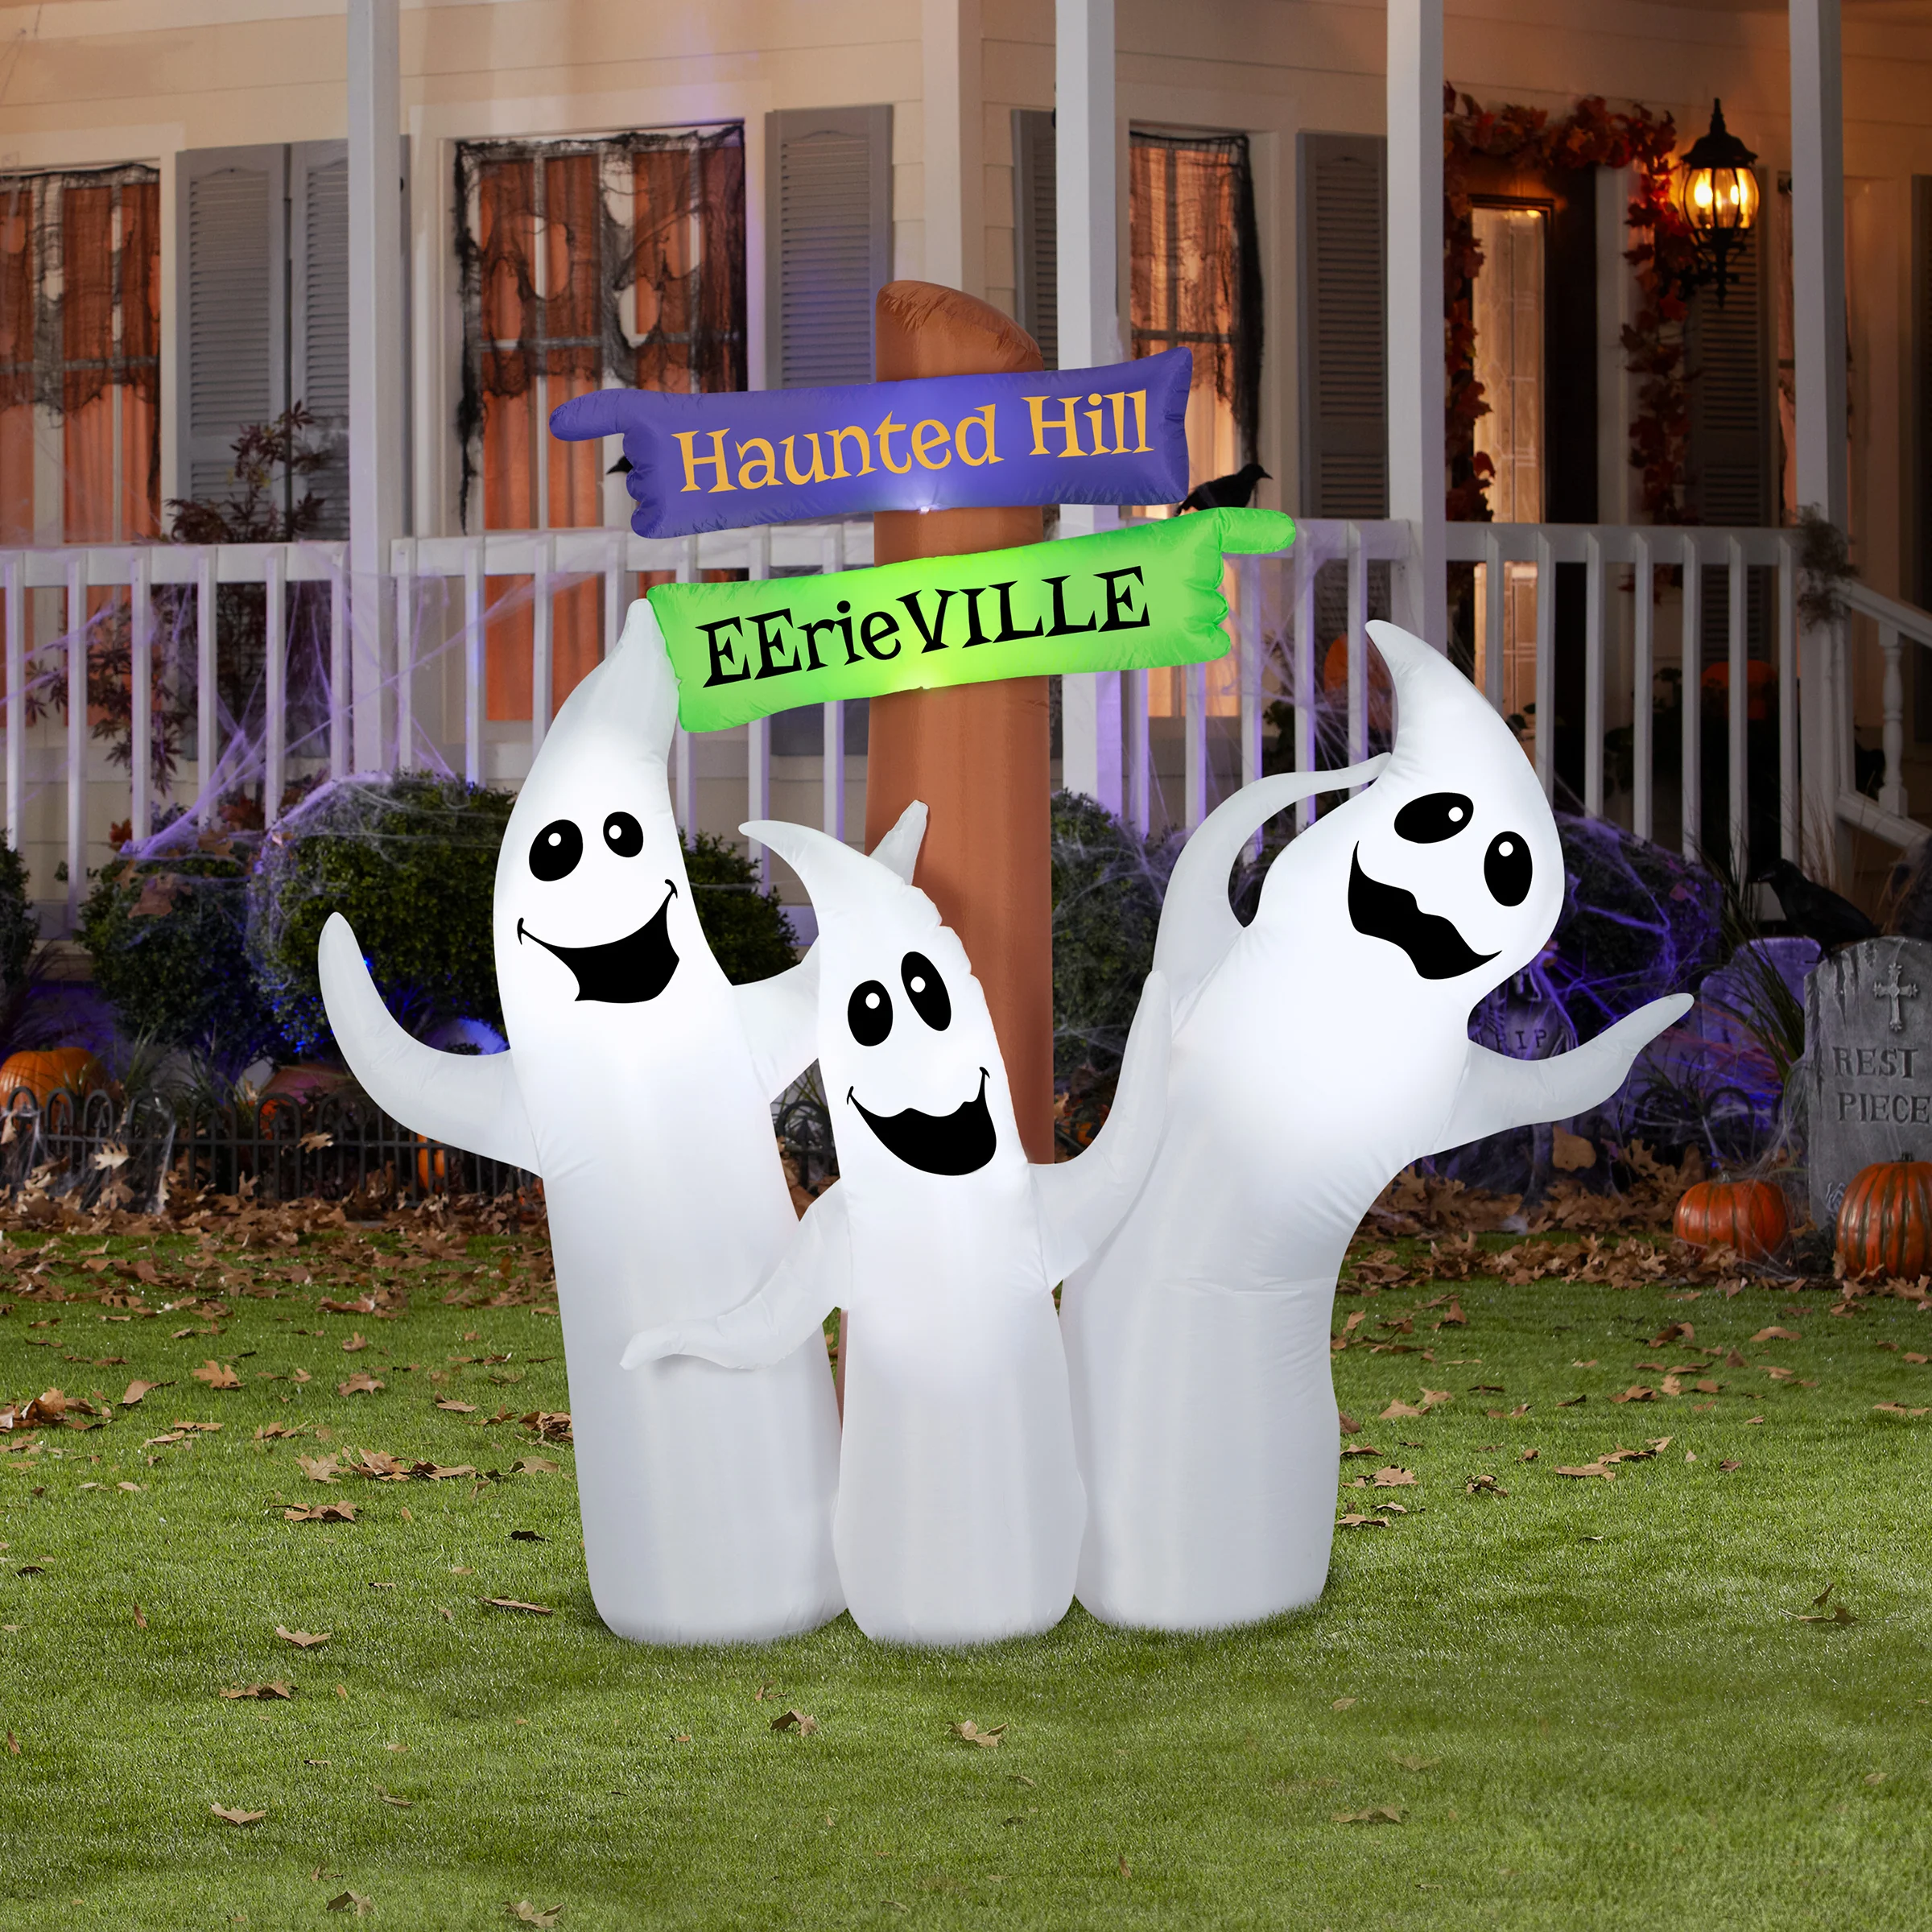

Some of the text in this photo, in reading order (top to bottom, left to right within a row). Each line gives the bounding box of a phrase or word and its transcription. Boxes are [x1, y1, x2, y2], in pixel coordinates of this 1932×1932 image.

[671, 389, 1155, 493] Haunted Hill
[695, 565, 1150, 688] EErieVILLE
[1833, 1047, 1918, 1079] REST
[1837, 1092, 1931, 1124] PIECE
